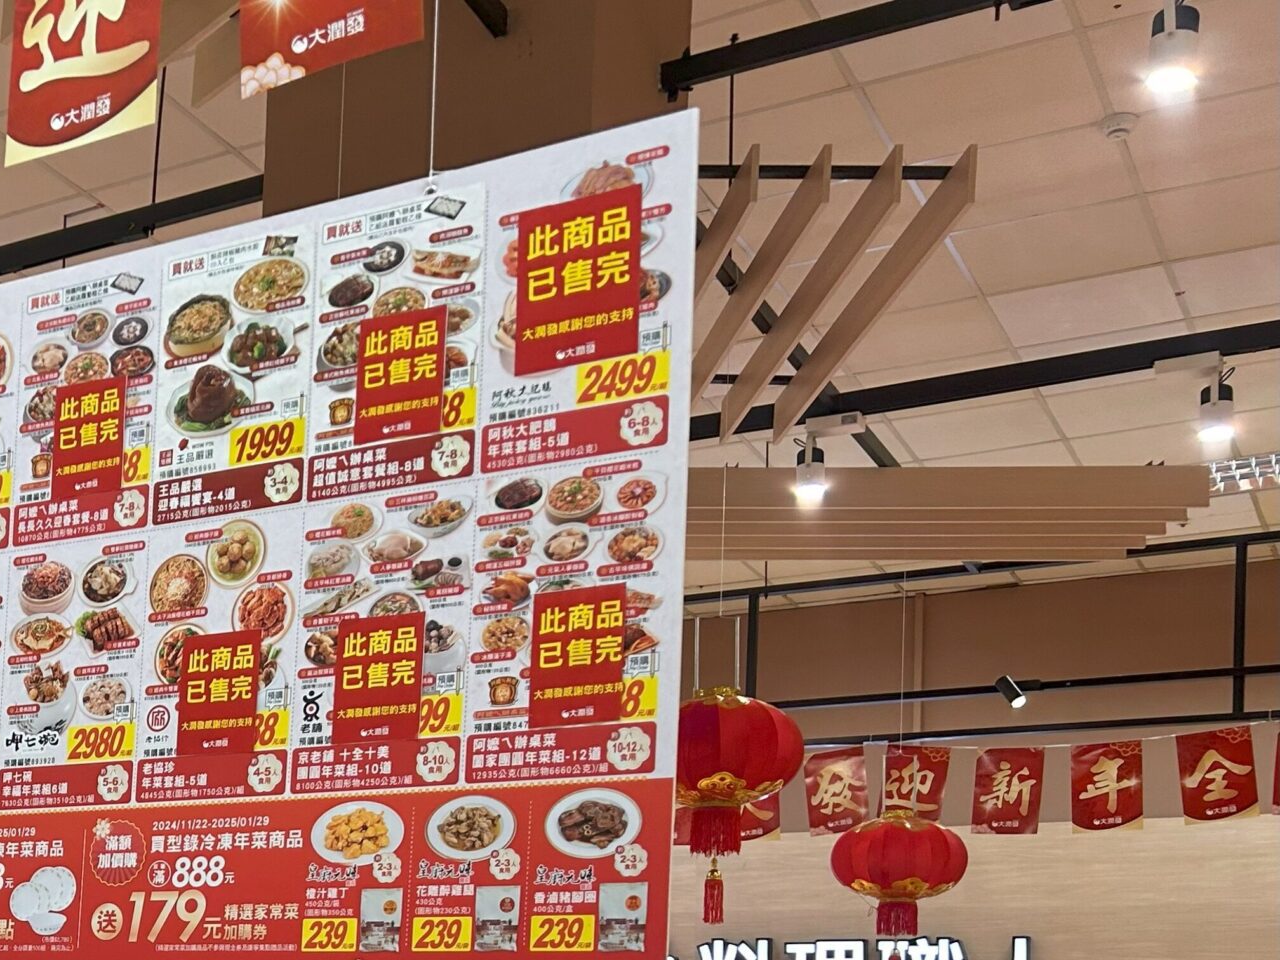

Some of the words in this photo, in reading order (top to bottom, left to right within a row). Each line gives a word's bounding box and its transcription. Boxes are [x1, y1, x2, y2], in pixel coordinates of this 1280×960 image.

[310, 10, 366, 48] 大潤發
[64, 94, 111, 127] 大潤發
[527, 206, 632, 261] 此商品
[528, 252, 631, 302] 已售完
[364, 320, 438, 357] 此商品
[364, 354, 437, 388] 已售完
[577, 358, 656, 404] 2499
[60, 388, 119, 421] 此商品
[59, 418, 119, 450] 已售完
[236, 421, 294, 463] 1999
[539, 600, 623, 635] 此商品
[343, 626, 417, 657] 此商品
[539, 635, 622, 668] 已售完
[187, 644, 254, 673] 此商品
[342, 660, 415, 689] 已售完
[186, 675, 252, 703] 已售完
[69, 726, 124, 759] 2980
[979, 761, 1037, 816] 新
[1079, 757, 1137, 813] 年
[1185, 749, 1252, 799] 全
[150, 830, 303, 852] 買型錄冷凍年菜商品
[224, 903, 299, 921] 精選家常菜
[222, 924, 267, 940] 加購券
[305, 920, 348, 949] 239
[414, 919, 462, 949] 239
[533, 918, 583, 949] 239
